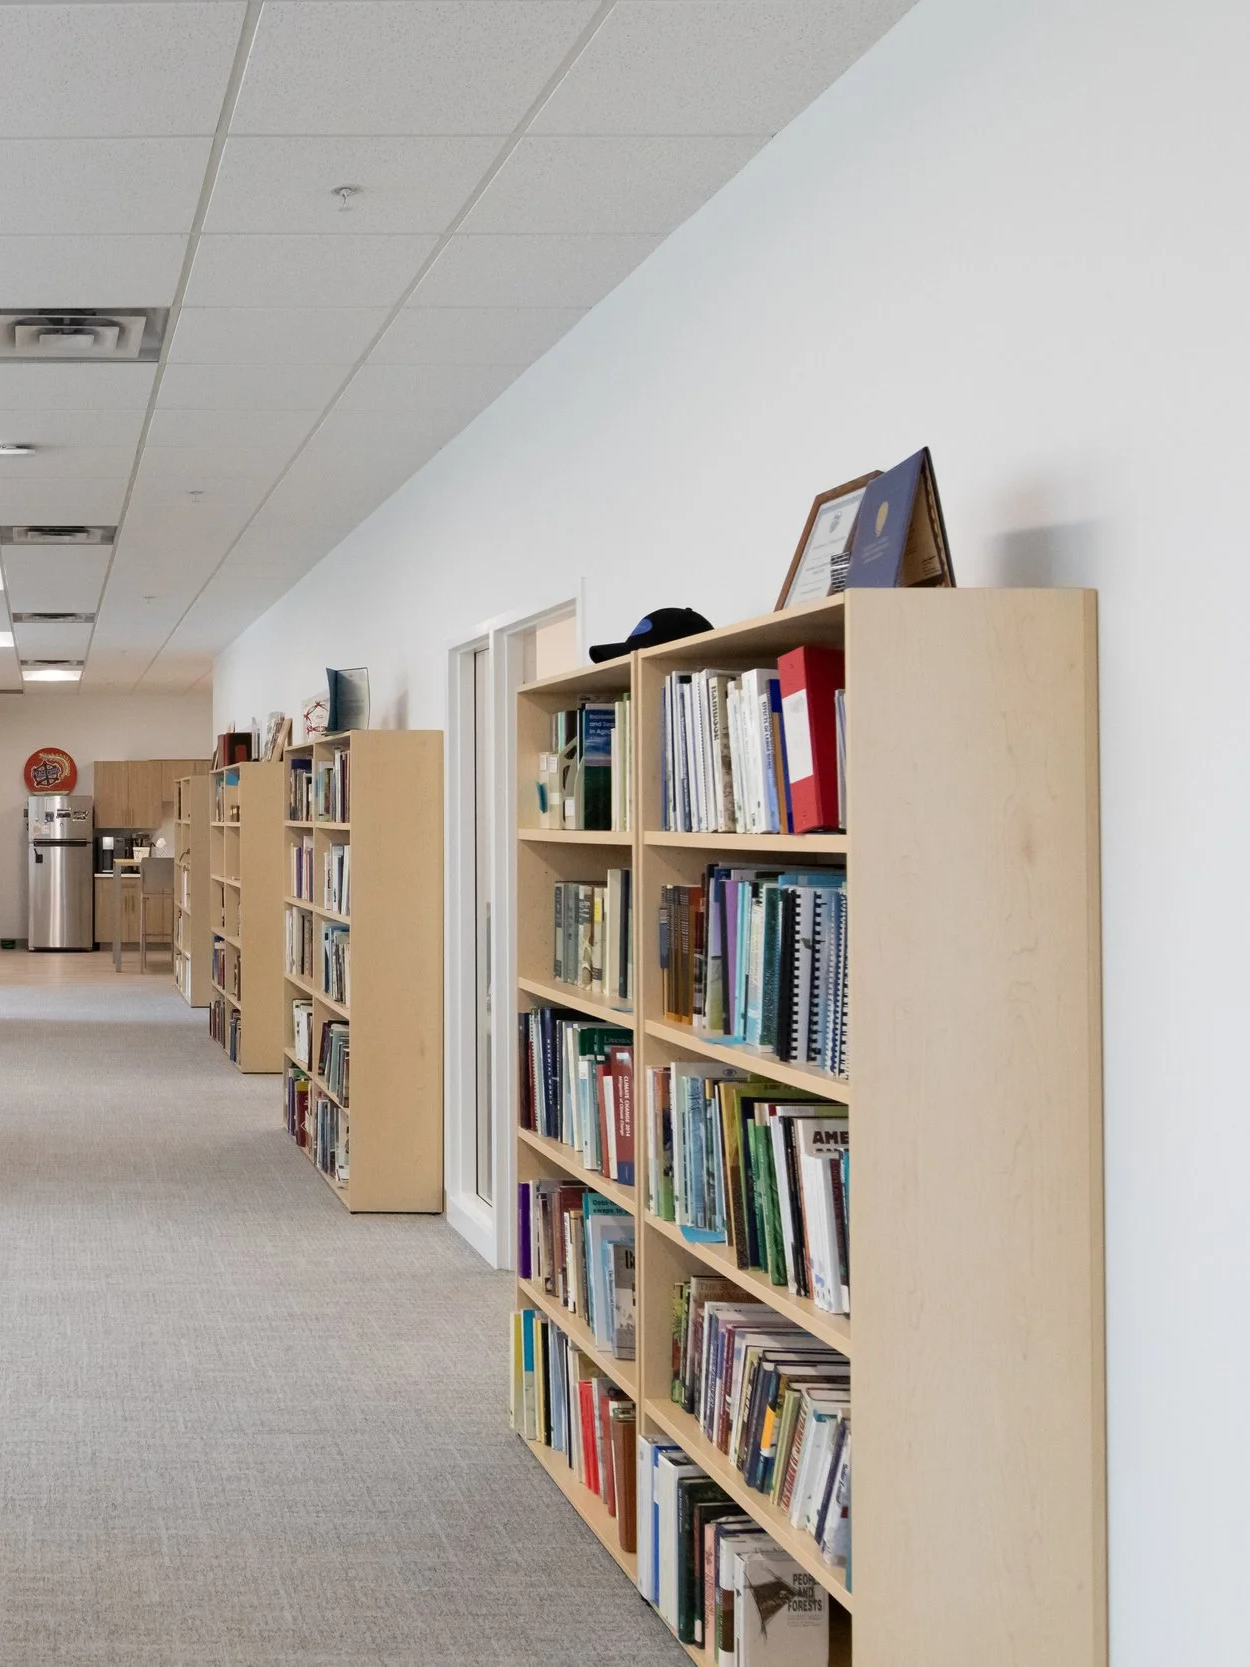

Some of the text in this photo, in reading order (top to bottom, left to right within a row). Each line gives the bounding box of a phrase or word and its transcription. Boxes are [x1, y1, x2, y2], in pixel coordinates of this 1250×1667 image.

[813, 1130, 848, 1145] AME
[793, 1573, 820, 1586] PEOP
[797, 1587, 815, 1599] AND
[787, 1600, 823, 1612] FORESTS
